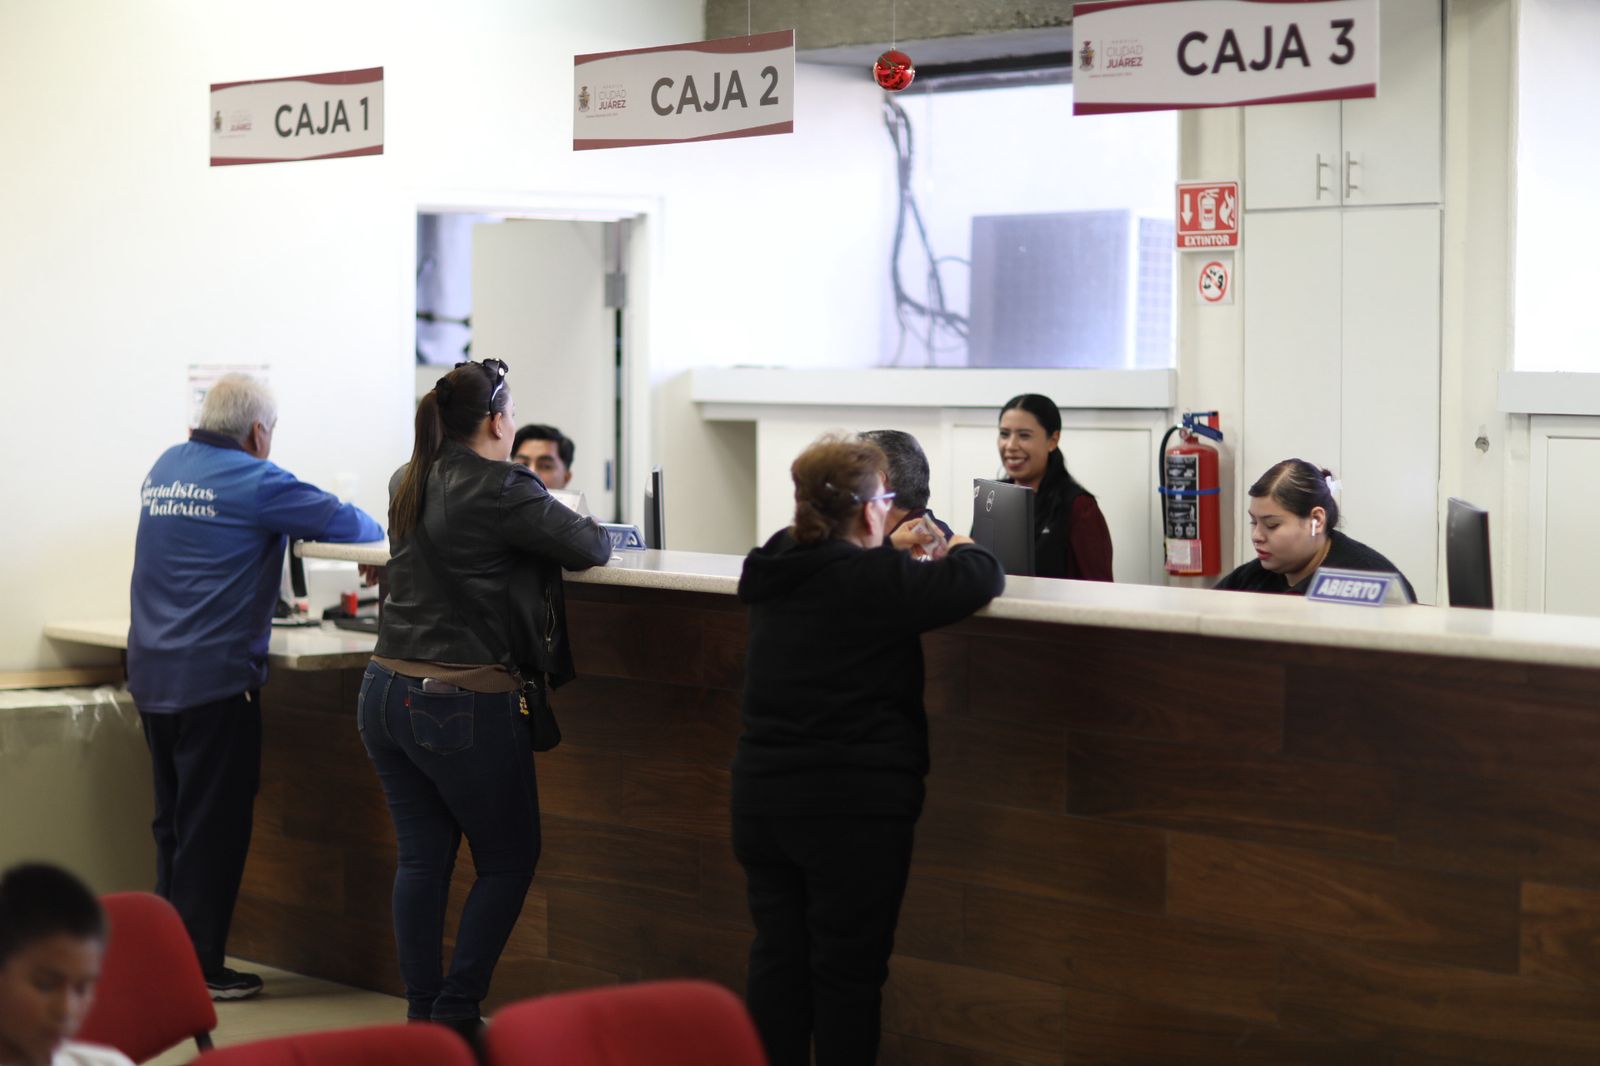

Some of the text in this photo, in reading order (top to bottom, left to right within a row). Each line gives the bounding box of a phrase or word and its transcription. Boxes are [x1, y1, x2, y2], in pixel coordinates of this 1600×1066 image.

[1106, 45, 1143, 57] CIUDAD
[1177, 19, 1355, 76] CAJA 3
[1106, 56, 1143, 69] JUÁREZ
[651, 65, 779, 116] CAJA 2
[599, 99, 627, 110] JUÁREZ
[275, 96, 369, 138] CAJA 1
[1184, 234, 1230, 247] EXTINTOR
[1317, 578, 1381, 600] ABIERTO
